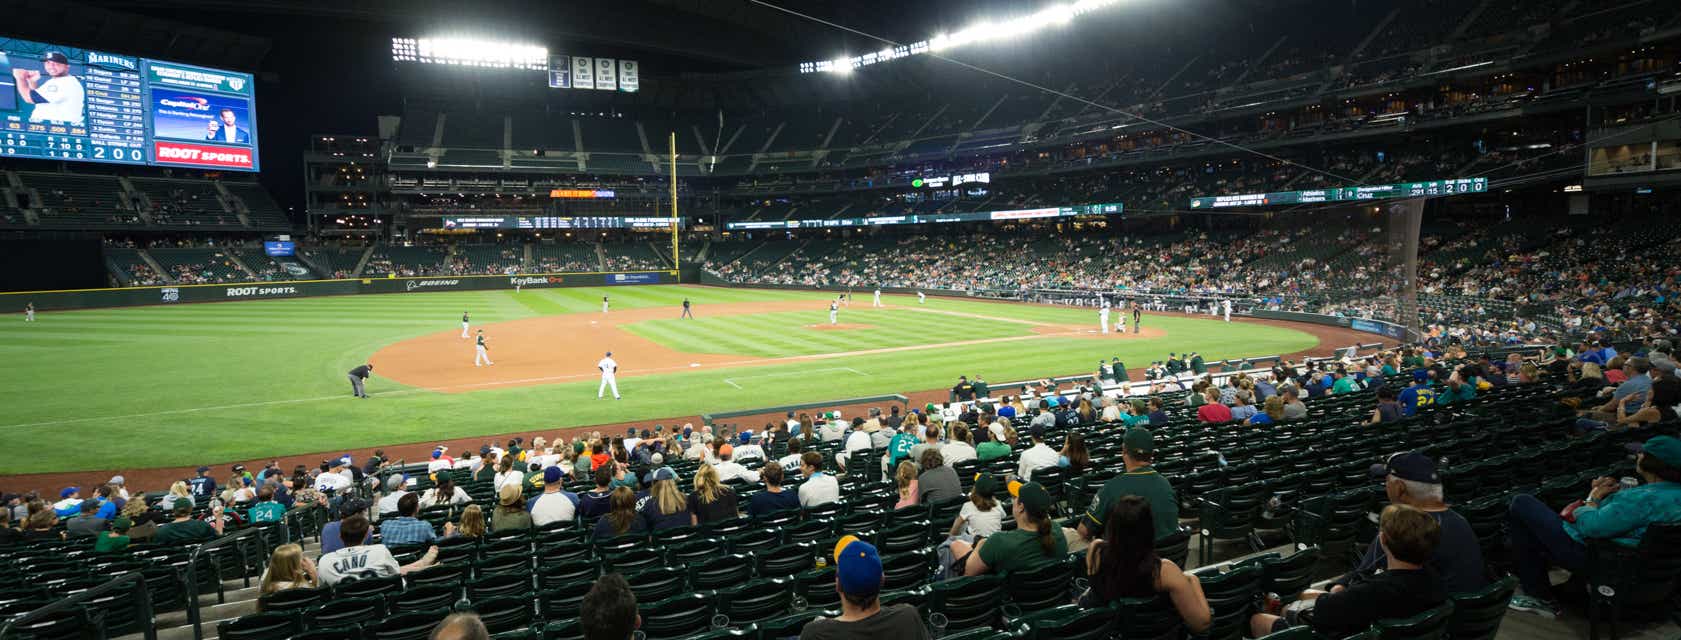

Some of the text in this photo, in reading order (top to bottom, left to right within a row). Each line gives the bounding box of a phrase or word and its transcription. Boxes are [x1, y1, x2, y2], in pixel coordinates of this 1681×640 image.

[88, 52, 135, 69] MARINERS
[94, 147, 142, 160] 2 0 0
[159, 147, 201, 160] ROOT
[510, 277, 548, 285] KeyBank
[226, 287, 256, 296] ROOT
[256, 509, 273, 522] 24
[332, 554, 368, 574] CANO
